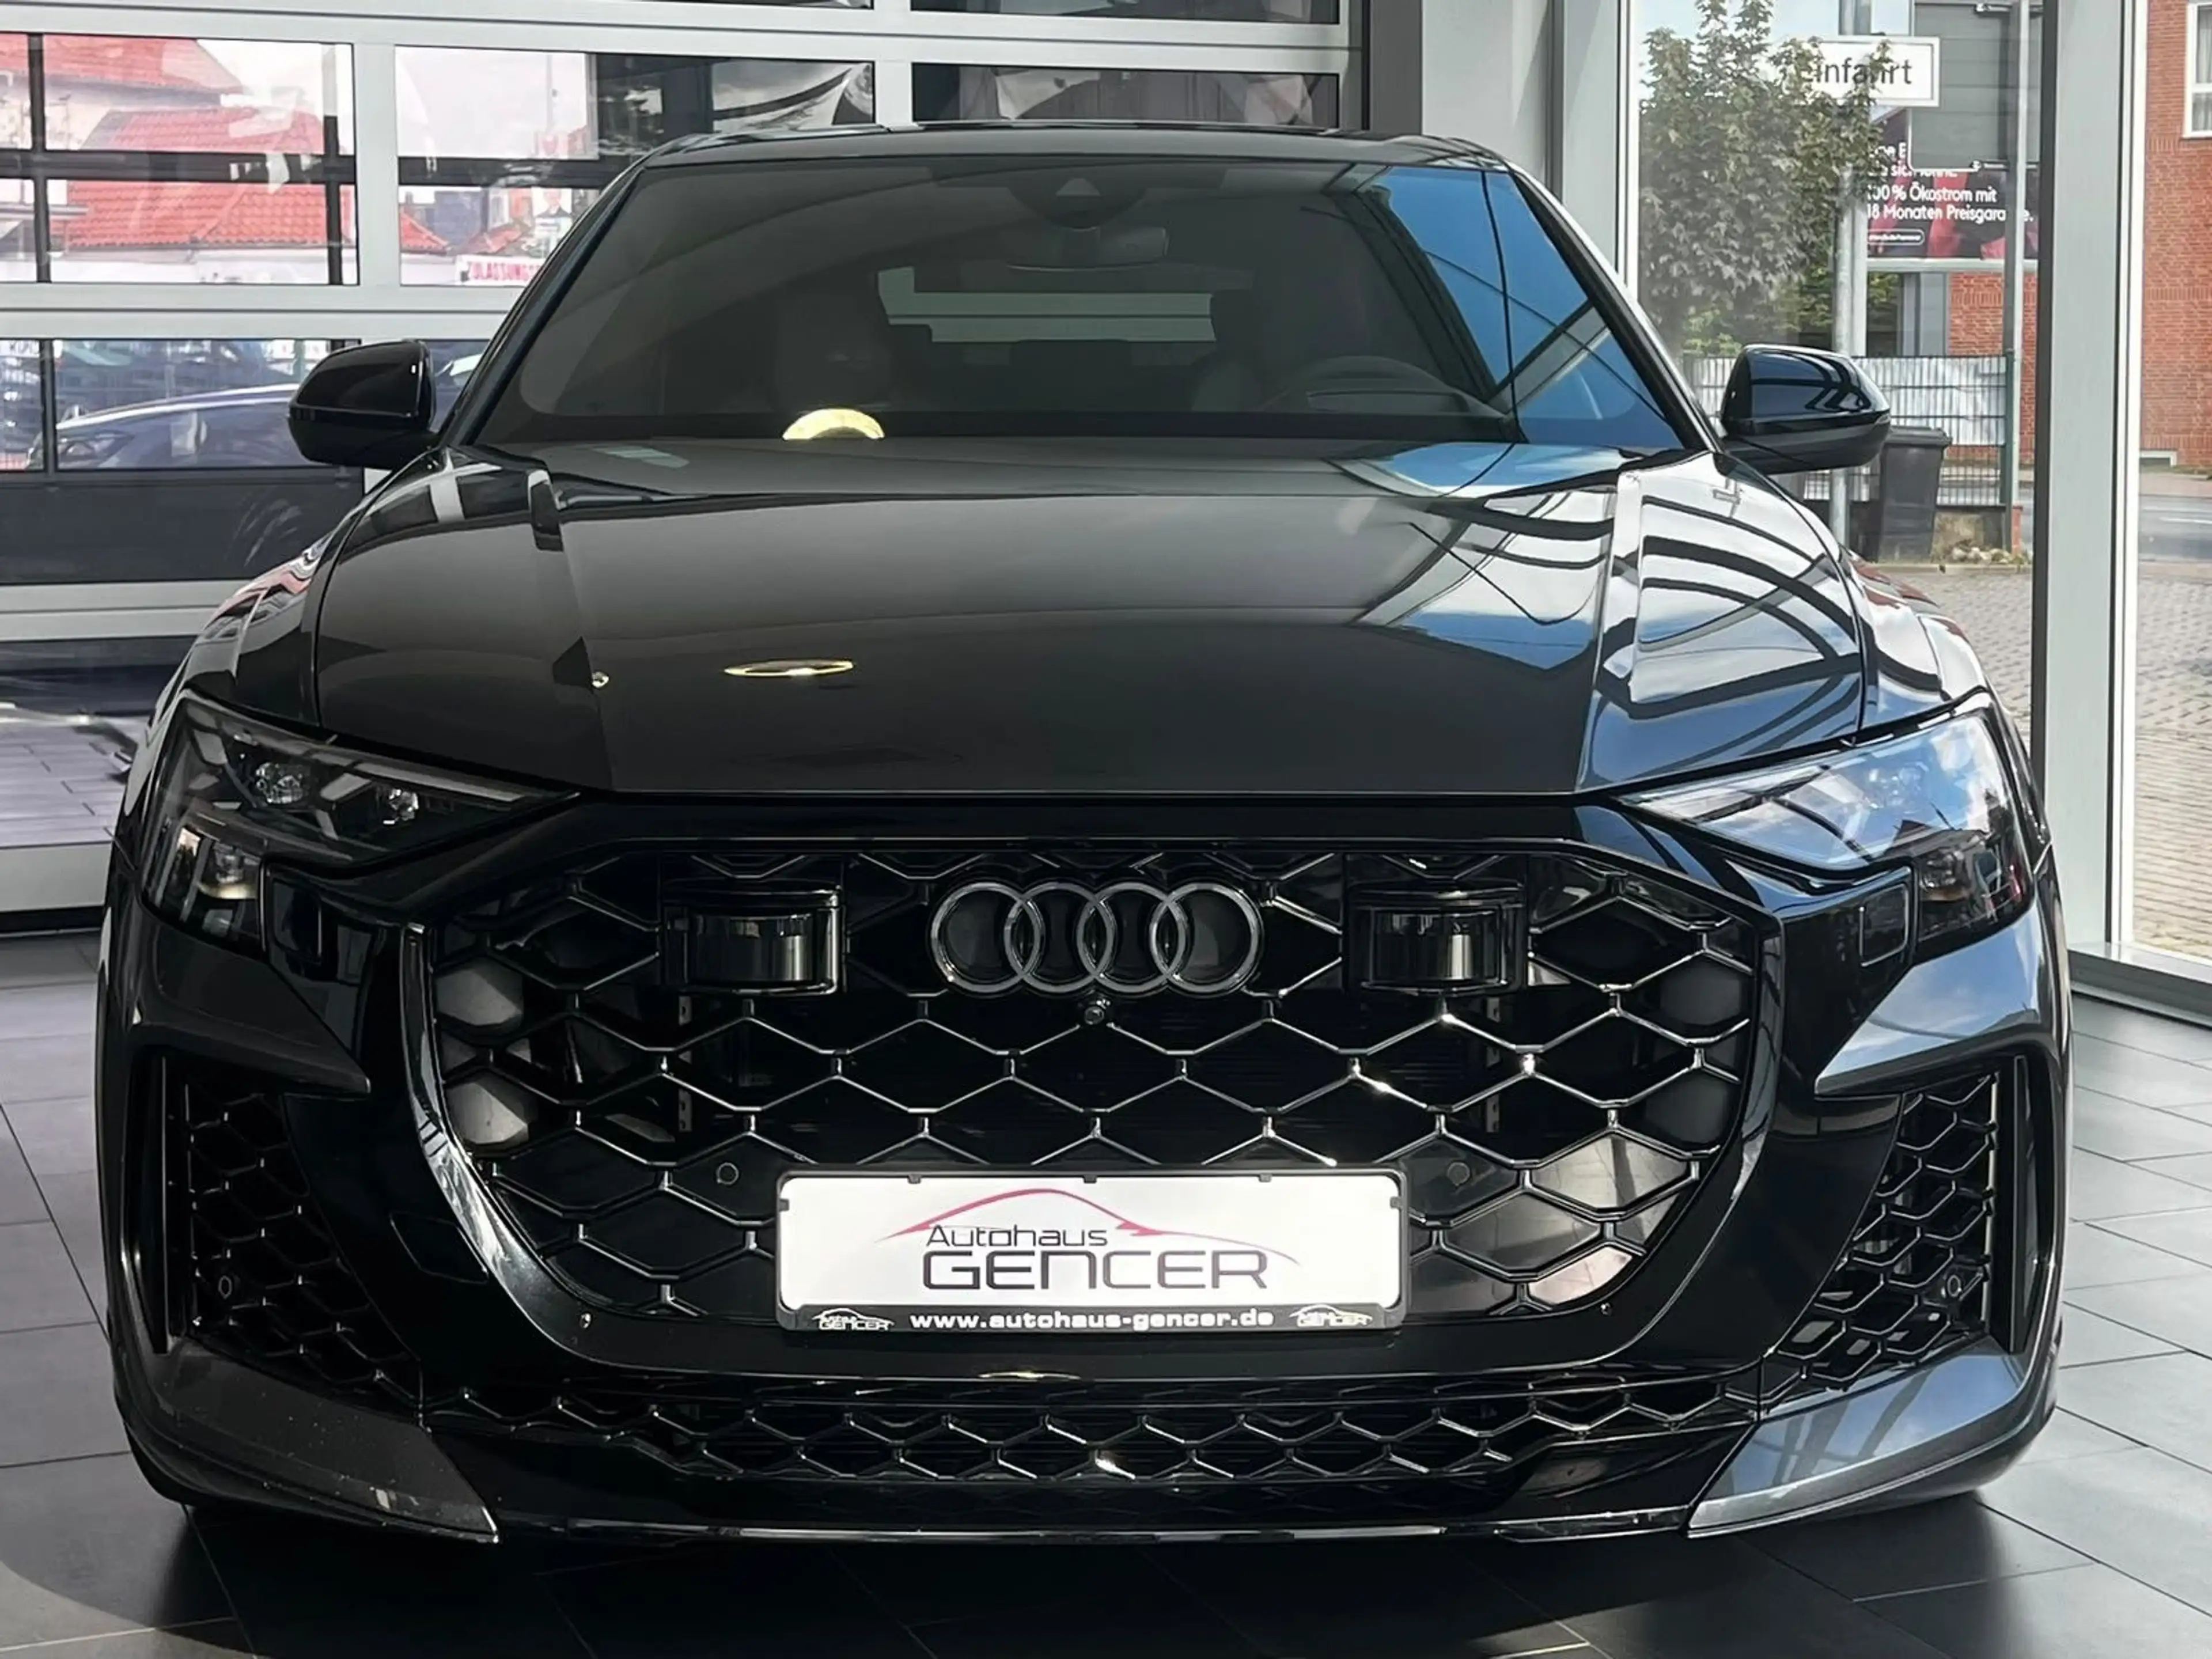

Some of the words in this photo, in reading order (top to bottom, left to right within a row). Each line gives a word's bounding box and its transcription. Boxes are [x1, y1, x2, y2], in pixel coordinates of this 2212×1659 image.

[1909, 181, 1972, 201] Ökostrom
[1975, 187, 1997, 202] mit
[1867, 203, 1880, 219] 18
[1883, 204, 1943, 219] Monaten
[926, 1225, 1107, 1247] Autohaus
[910, 1308, 1274, 1331] www.autohaus-gencer.de
